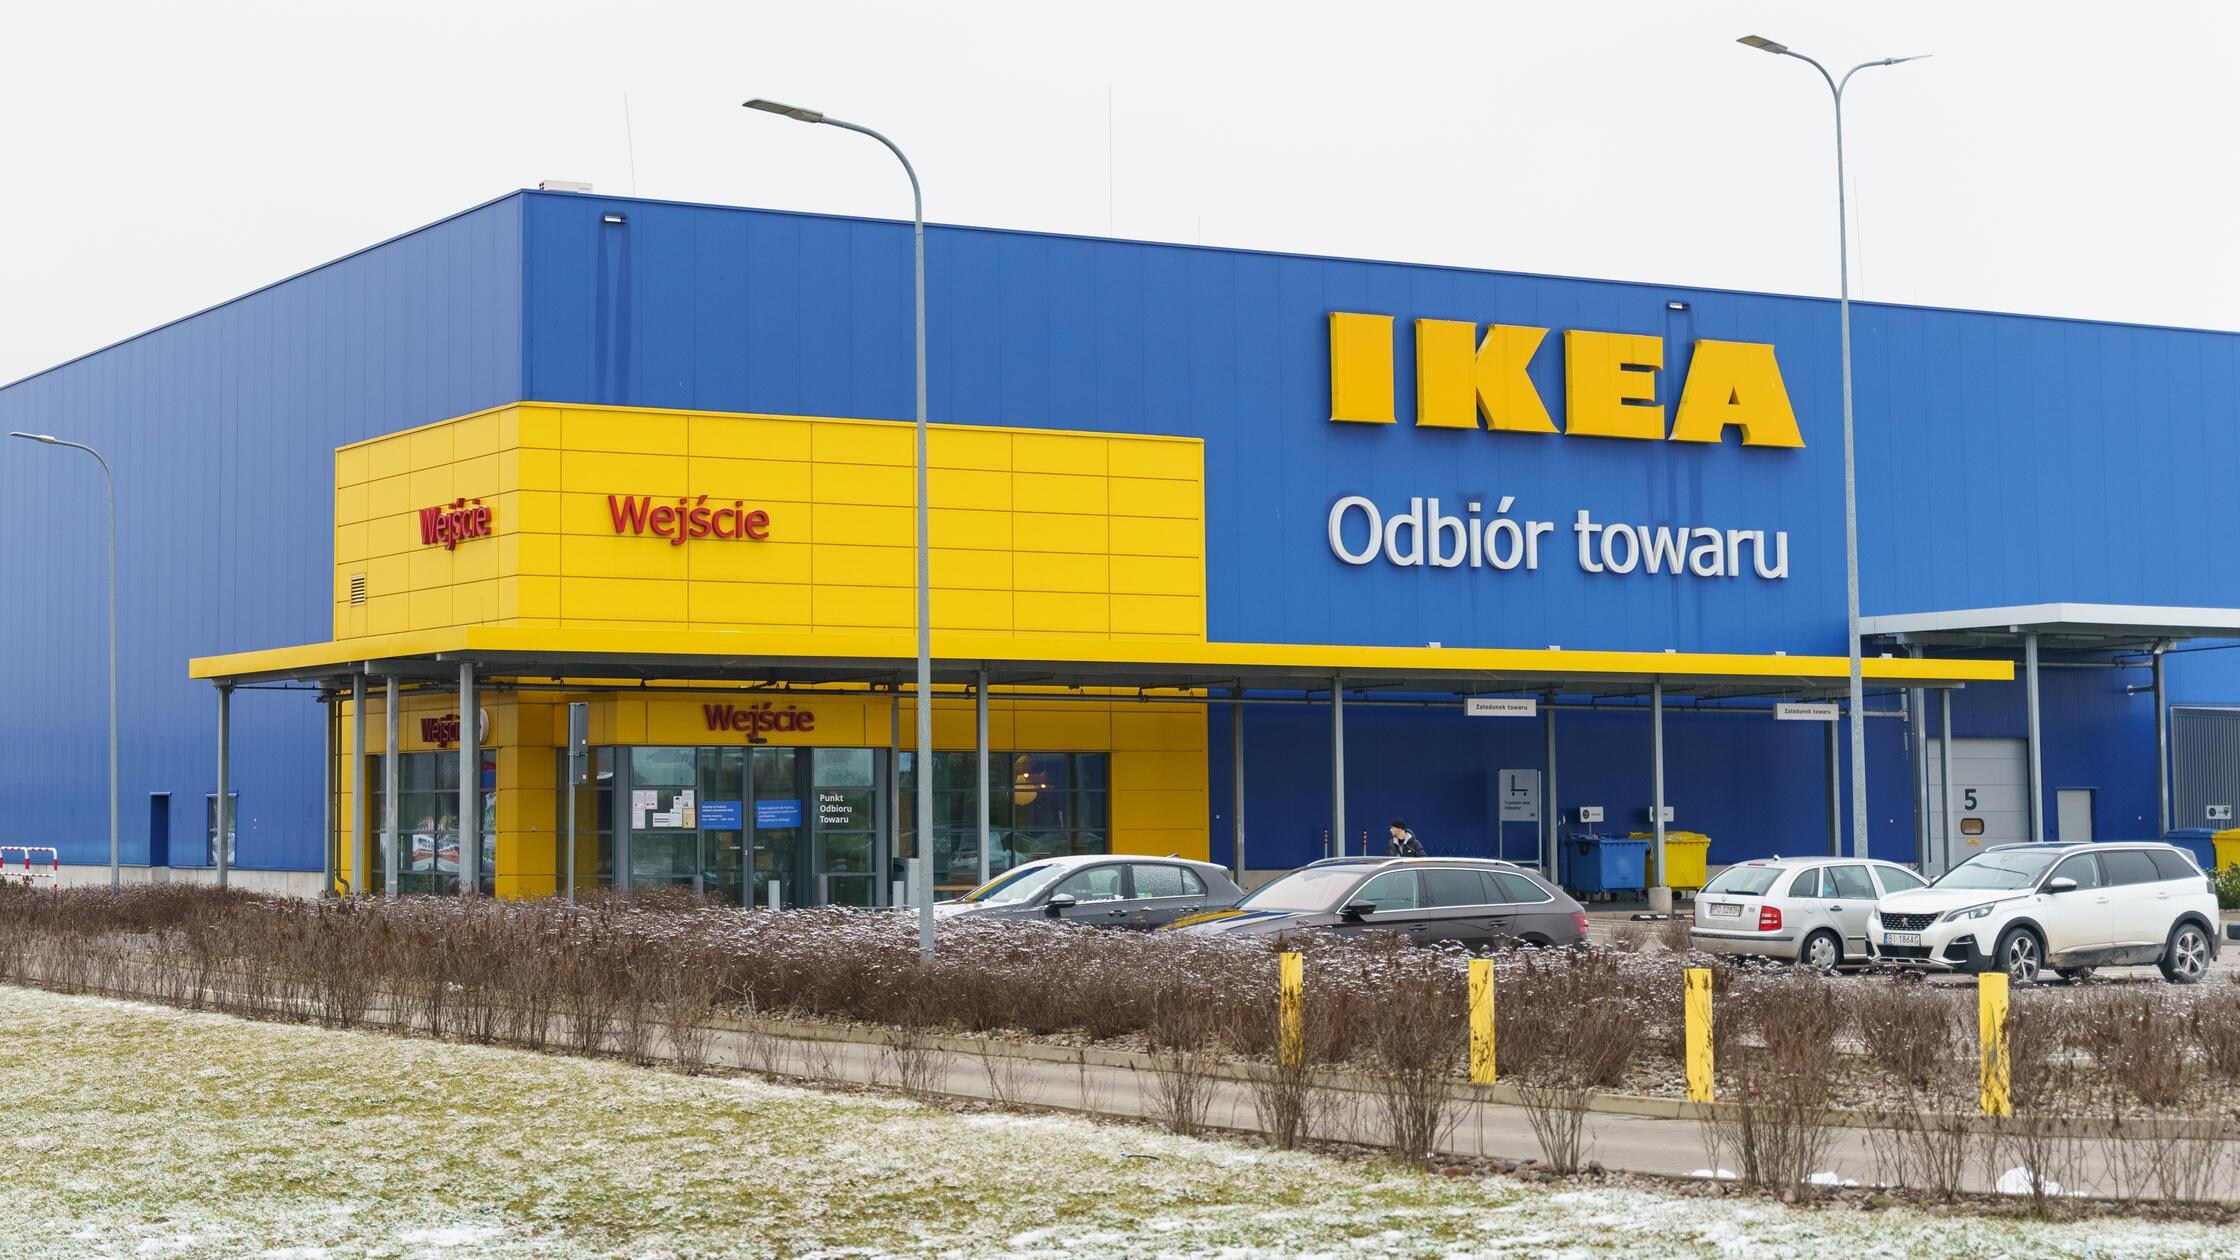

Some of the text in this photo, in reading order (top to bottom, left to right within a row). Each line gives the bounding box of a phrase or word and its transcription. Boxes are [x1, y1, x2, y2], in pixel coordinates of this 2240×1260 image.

[1329, 312, 1806, 448] IKEA
[419, 498, 492, 550] Wejście
[608, 495, 769, 545] Wejście
[1328, 496, 1789, 579] Odbiór towaru
[704, 702, 815, 738] Wejście
[819, 794, 844, 802] Punkt
[819, 804, 852, 813] Odbioru
[1965, 789, 1977, 810] 5
[819, 815, 849, 823] Towaru
[1888, 934, 1896, 943] BI
